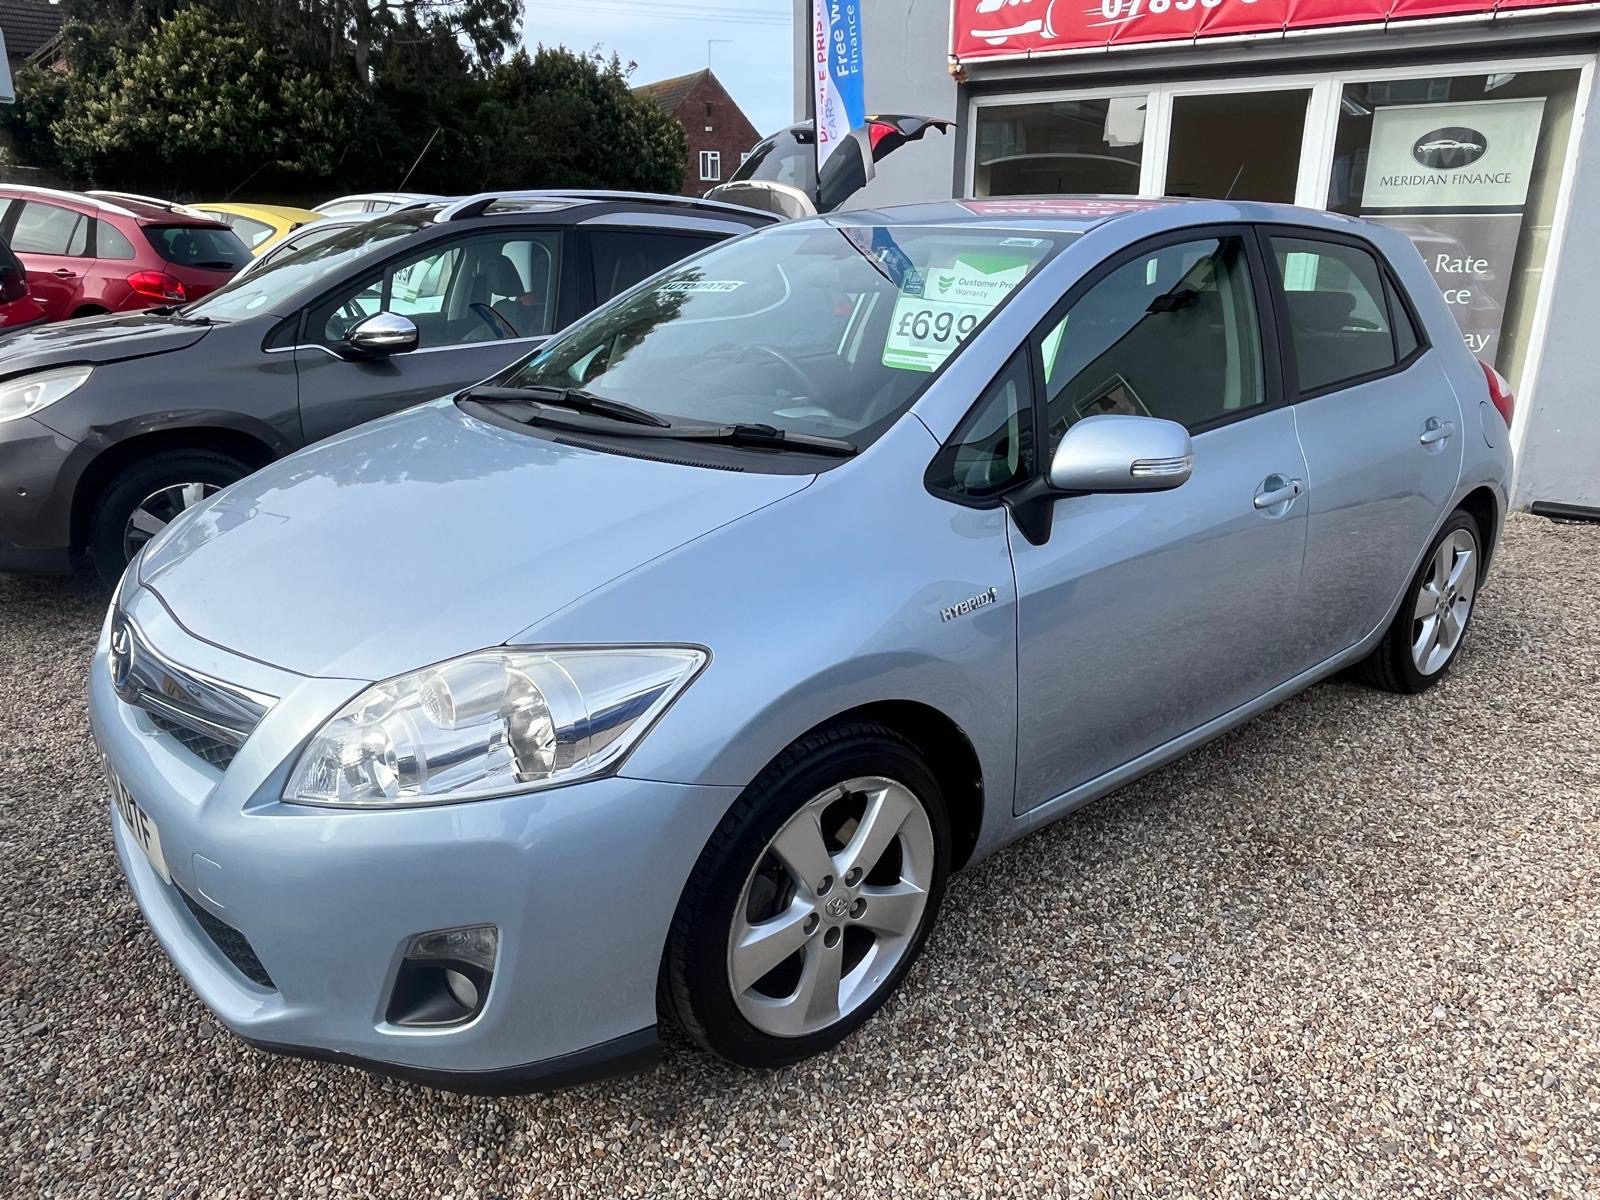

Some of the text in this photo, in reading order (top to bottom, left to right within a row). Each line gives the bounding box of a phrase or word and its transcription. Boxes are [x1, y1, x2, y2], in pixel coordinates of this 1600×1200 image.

[846, 4, 859, 74] Finance
[833, 29, 849, 77] Free
[825, 98, 838, 140] CARS
[1379, 172, 1512, 187] MERIDIAN FINANCE
[1435, 253, 1489, 274] Rate
[955, 289, 988, 298] Warranty
[958, 277, 1018, 289] Customer Pro
[940, 591, 988, 623] HYBRID
